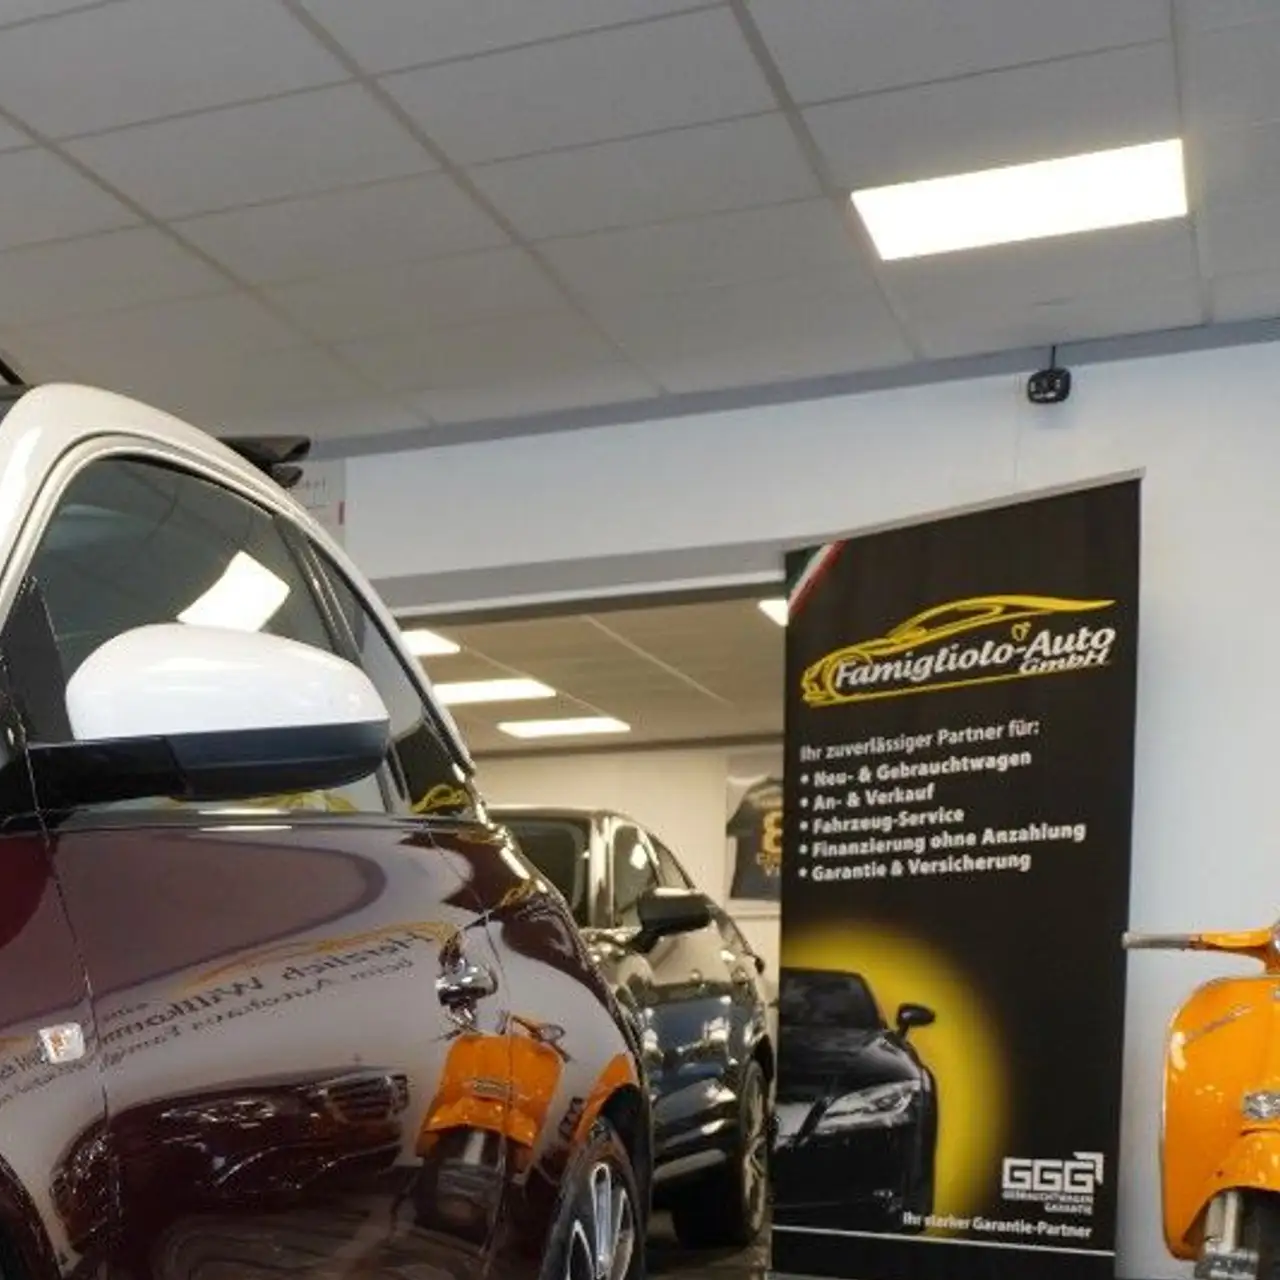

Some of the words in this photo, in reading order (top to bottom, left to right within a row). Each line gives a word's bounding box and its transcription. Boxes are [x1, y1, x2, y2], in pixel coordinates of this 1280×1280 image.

[835, 626, 1116, 688] Famigliolo-Auto
[1019, 648, 1110, 676] GmbH
[800, 746, 822, 762] Ihr
[826, 733, 933, 760] zuverlässiger
[938, 723, 1004, 746] Partner
[1008, 719, 1040, 739] für:
[813, 771, 853, 787] Neu-
[858, 766, 871, 783] &
[876, 751, 1032, 781] Gebrauchtwagen
[813, 795, 842, 811] An-
[847, 792, 861, 808] &
[865, 783, 935, 806] Verkauf
[813, 806, 964, 834] Fahrzeug-Service
[812, 836, 925, 857] Finanzierung
[930, 831, 976, 849] ohne
[981, 822, 1086, 846] Anzahlung
[812, 861, 887, 882] Garantie
[890, 861, 904, 877] &
[908, 853, 1032, 876] Versicherung
[1002, 1157, 1096, 1194] GGG
[902, 1211, 922, 1226] Ihr
[924, 1215, 970, 1229] starker
[972, 1216, 1093, 1238] Garantie-Partner
